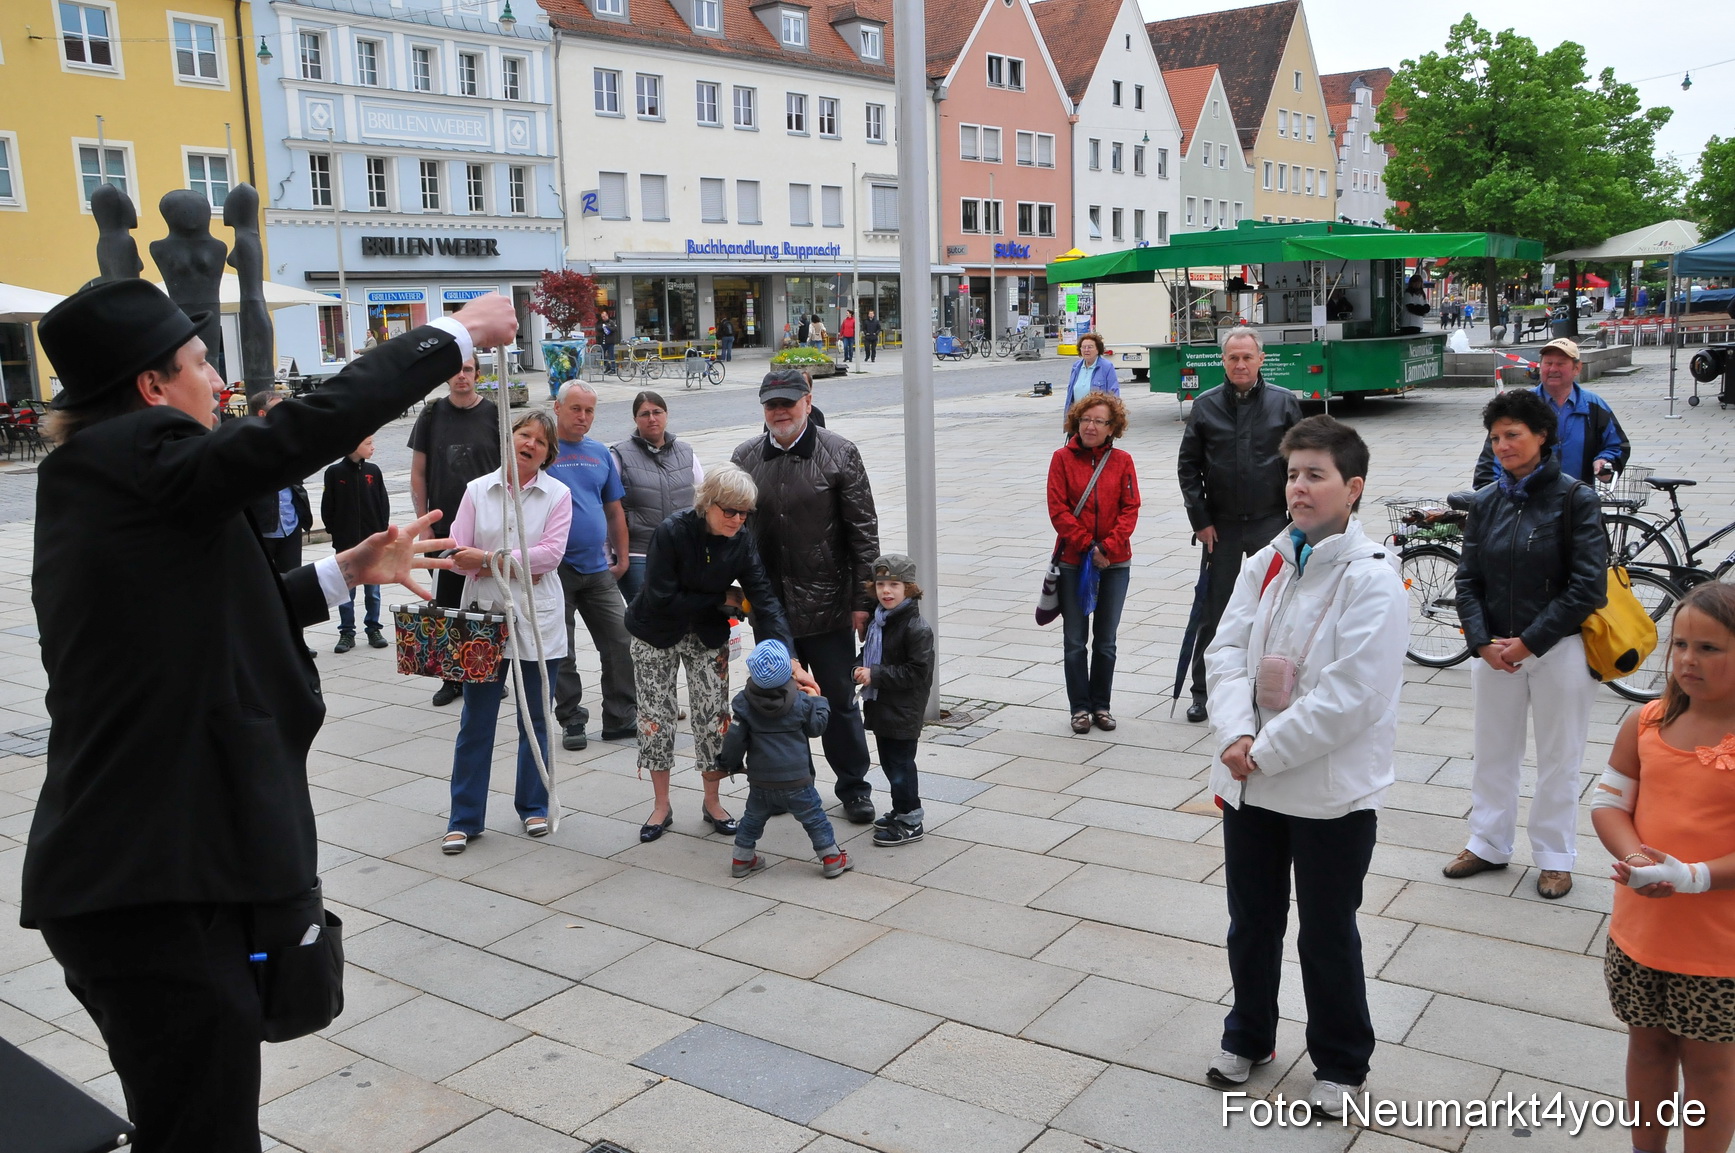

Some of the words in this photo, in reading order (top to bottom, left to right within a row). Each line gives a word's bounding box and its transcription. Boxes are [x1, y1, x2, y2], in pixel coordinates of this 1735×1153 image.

[367, 111, 428, 133] BRILLEN
[430, 117, 484, 137] WEBER
[361, 236, 434, 256] BRILLEN
[435, 237, 501, 256] WEBER
[686, 239, 779, 259] Buchhandlung
[782, 241, 841, 259] Rupprecht
[371, 291, 400, 301] BRILLEN
[400, 291, 422, 301] WEBER
[446, 291, 470, 300] BRILLEN
